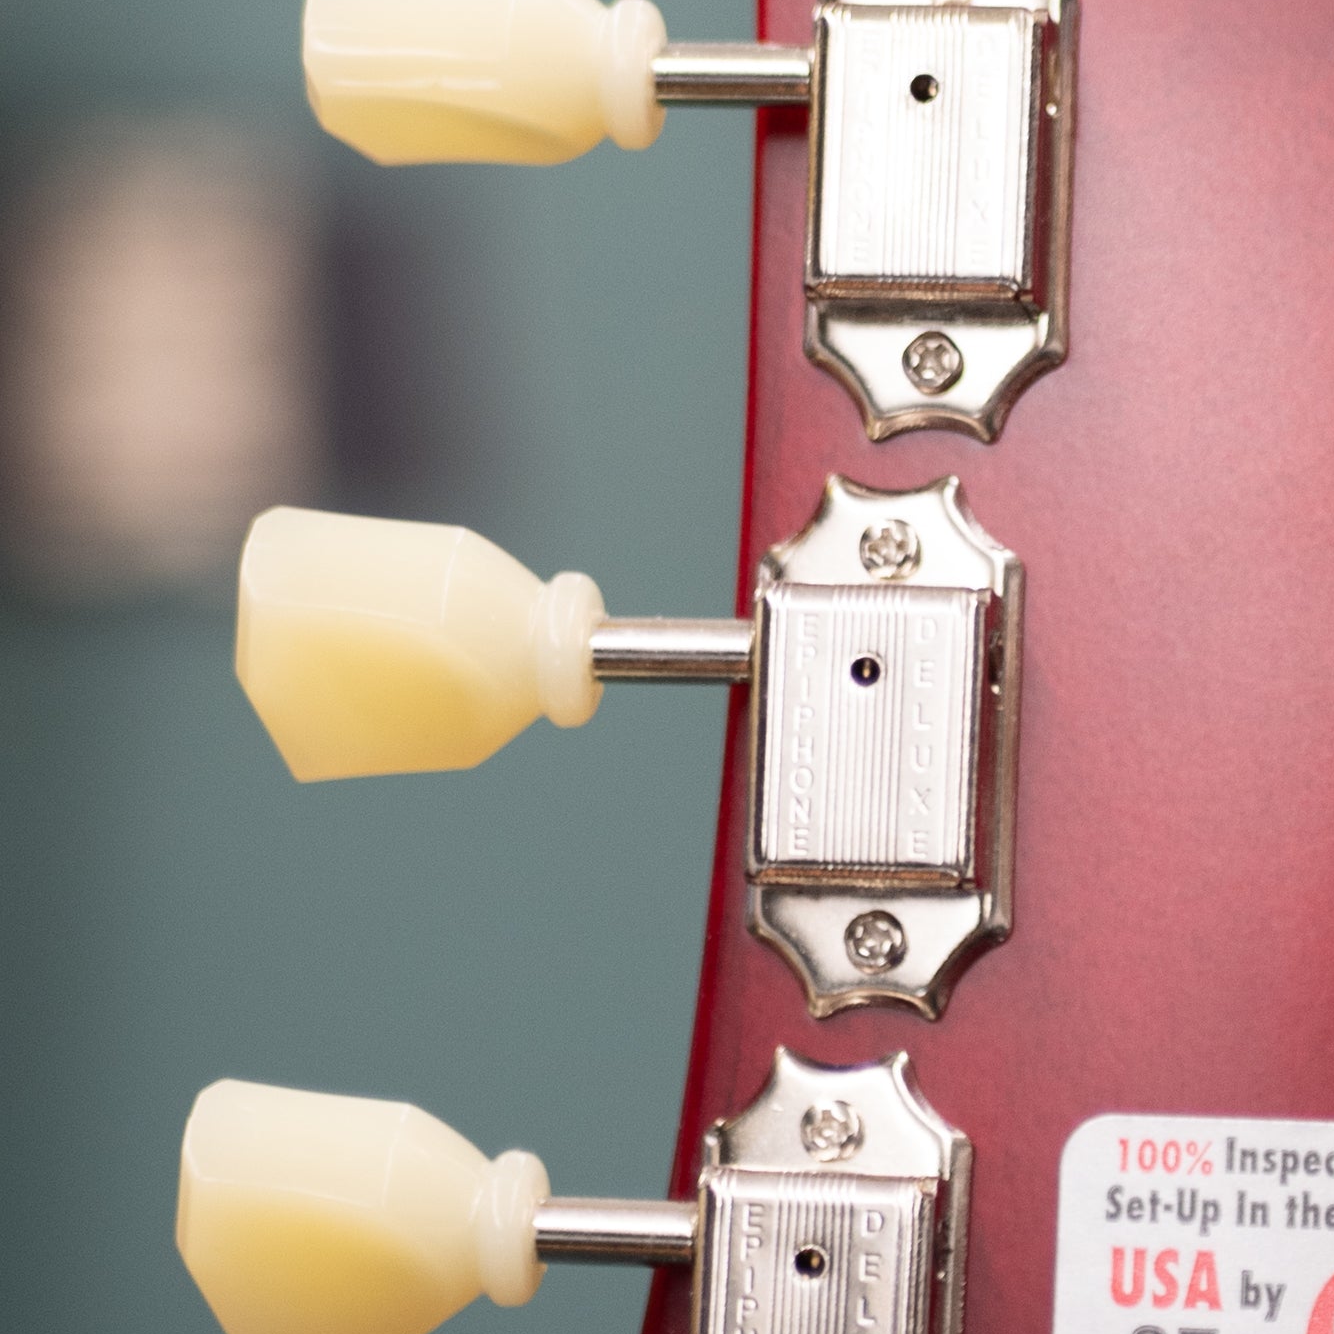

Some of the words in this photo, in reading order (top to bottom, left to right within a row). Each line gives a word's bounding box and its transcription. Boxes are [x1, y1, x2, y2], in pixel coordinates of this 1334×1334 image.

[787, 613, 822, 858] EPIPHONE
[907, 615, 938, 860] DELUXE
[1118, 1137, 1214, 1176] 100%
[1105, 1184, 1221, 1236] Set-Up
[1110, 1245, 1223, 1311] USA
[1239, 1269, 1286, 1322] by
